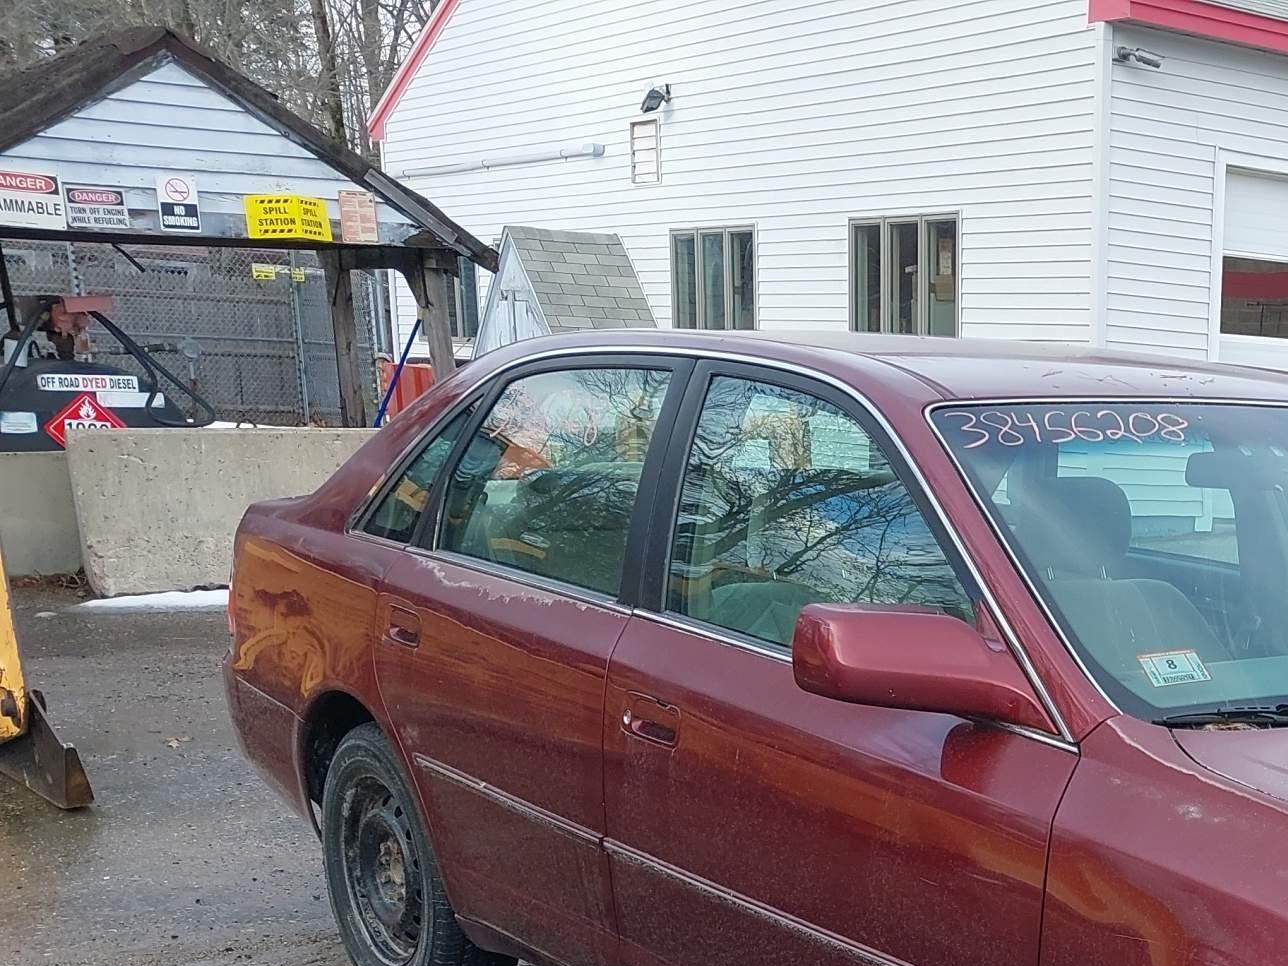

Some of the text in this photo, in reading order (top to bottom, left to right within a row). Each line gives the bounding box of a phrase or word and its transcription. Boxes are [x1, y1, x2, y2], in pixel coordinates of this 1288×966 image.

[74, 192, 117, 203] DANGER
[70, 206, 126, 217] TURN OFF ENGINE
[173, 205, 186, 215] NO
[262, 206, 289, 216] SPILL
[302, 207, 318, 218] SPILL
[71, 215, 128, 227] WHILE REFUELING
[163, 215, 199, 228] SMOKING
[258, 217, 297, 228] STATION
[300, 218, 323, 230] STATION
[40, 376, 137, 390] OFF ROAD DYED DIESEL
[944, 410, 1189, 449] 38456208
[1165, 659, 1178, 670] 8
